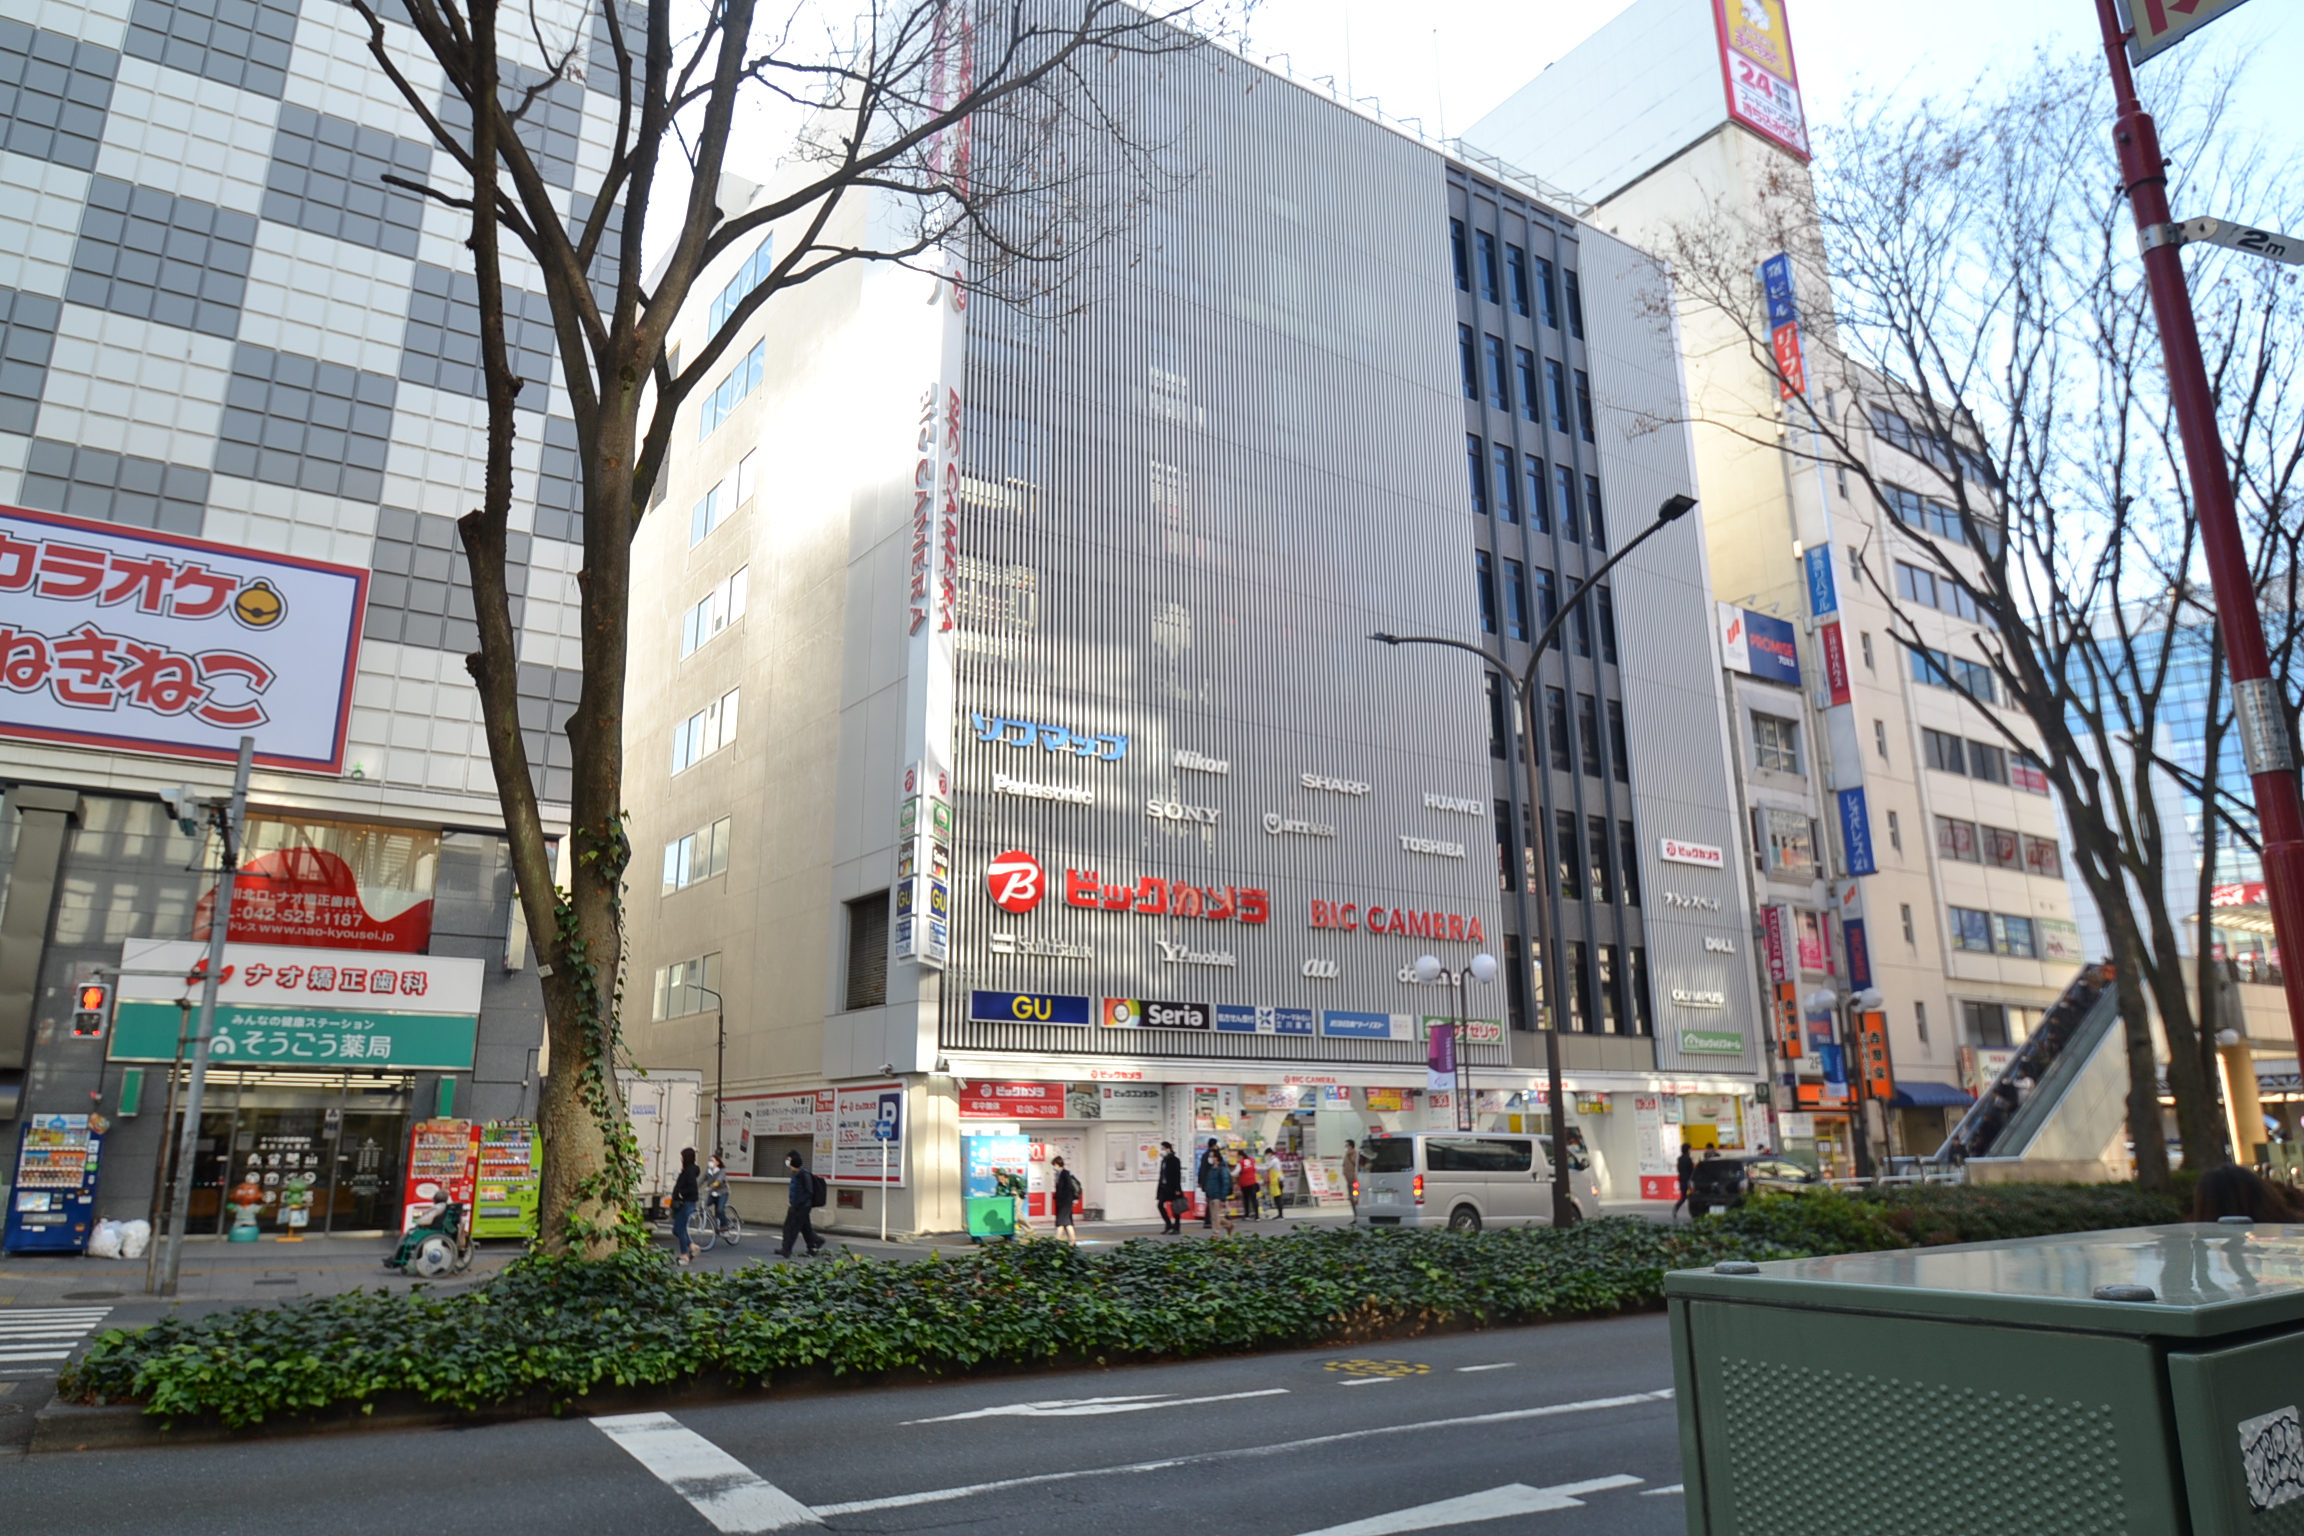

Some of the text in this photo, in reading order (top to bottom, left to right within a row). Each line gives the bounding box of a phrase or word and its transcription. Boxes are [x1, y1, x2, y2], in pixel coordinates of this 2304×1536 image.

[1738, 60, 1774, 99] 24
[2237, 230, 2286, 257] 2m
[0, 532, 238, 616] カラオケ
[1749, 632, 1796, 660] PROMISE
[1174, 749, 1229, 775] Nikon
[992, 773, 1094, 806] Panasonic
[1301, 772, 1371, 797] SHARP
[1146, 799, 1221, 826] SONY
[1423, 792, 1485, 817] HUAWEI
[1398, 834, 1467, 860] TOSHIBA
[897, 888, 913, 909] GU
[931, 888, 947, 913] GU
[1066, 868, 1269, 924] ビックカメラ
[259, 923, 395, 943] www.nao-kyousei.jp
[1308, 898, 1486, 943] BIC CAMERA
[1017, 935, 1093, 960] SoftBank
[1704, 936, 1736, 954] DELL
[245, 962, 429, 997] ナオ矯正歯科
[1302, 957, 1340, 979] au
[1011, 995, 1053, 1022] GU
[1672, 988, 1725, 1005] OLYMPUS
[231, 1014, 375, 1031] みんなの健康ステーション
[1148, 1004, 1204, 1028] Seria
[240, 1030, 392, 1060] そうごう薬局
[1099, 1070, 1143, 1080] ビックカメラ
[1305, 1076, 1337, 1085] CAMERA
[995, 1085, 1046, 1098] ビックカメラ
[881, 1101, 897, 1126] P
